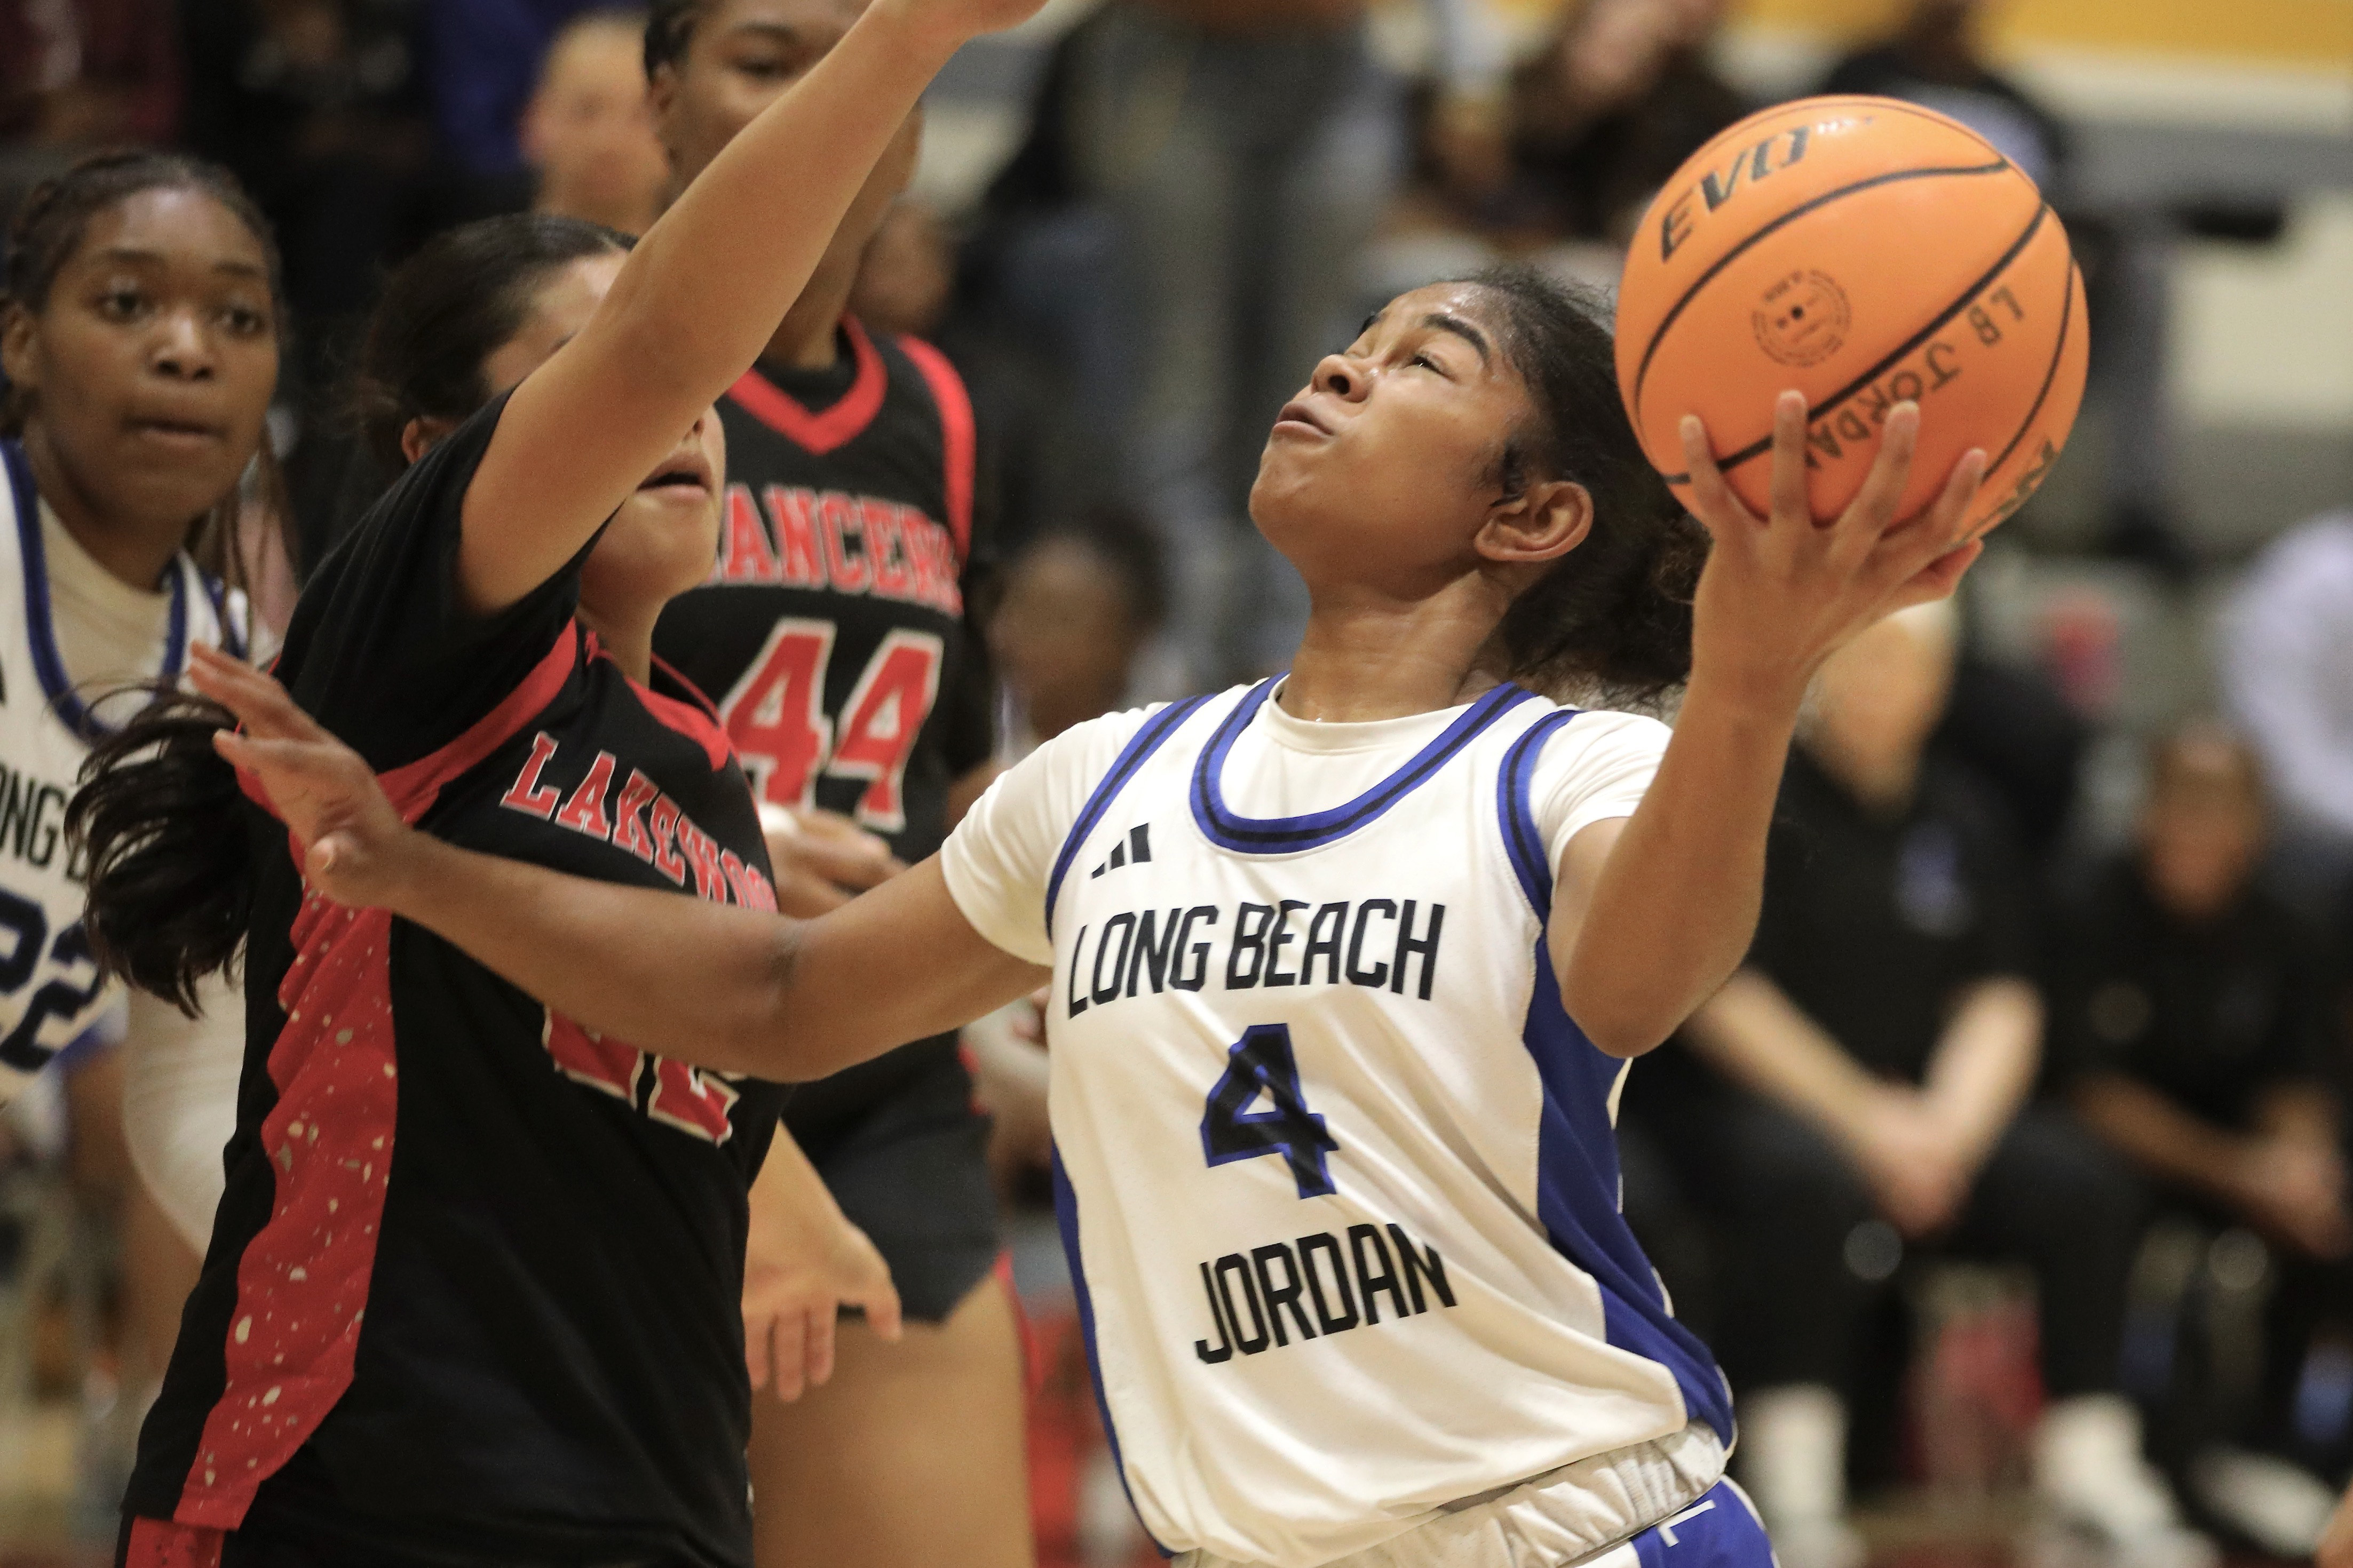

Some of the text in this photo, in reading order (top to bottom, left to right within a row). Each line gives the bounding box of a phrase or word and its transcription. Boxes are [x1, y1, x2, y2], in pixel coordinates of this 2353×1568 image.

[1661, 126, 1810, 263] EVO
[1968, 285, 2024, 347] LB
[706, 481, 964, 617] ANCERS
[719, 617, 945, 833] 44
[1068, 898, 1446, 1020] LONG BEACH
[1199, 1023, 1340, 1200] 4
[1194, 1222, 1458, 1364] JORDAN
